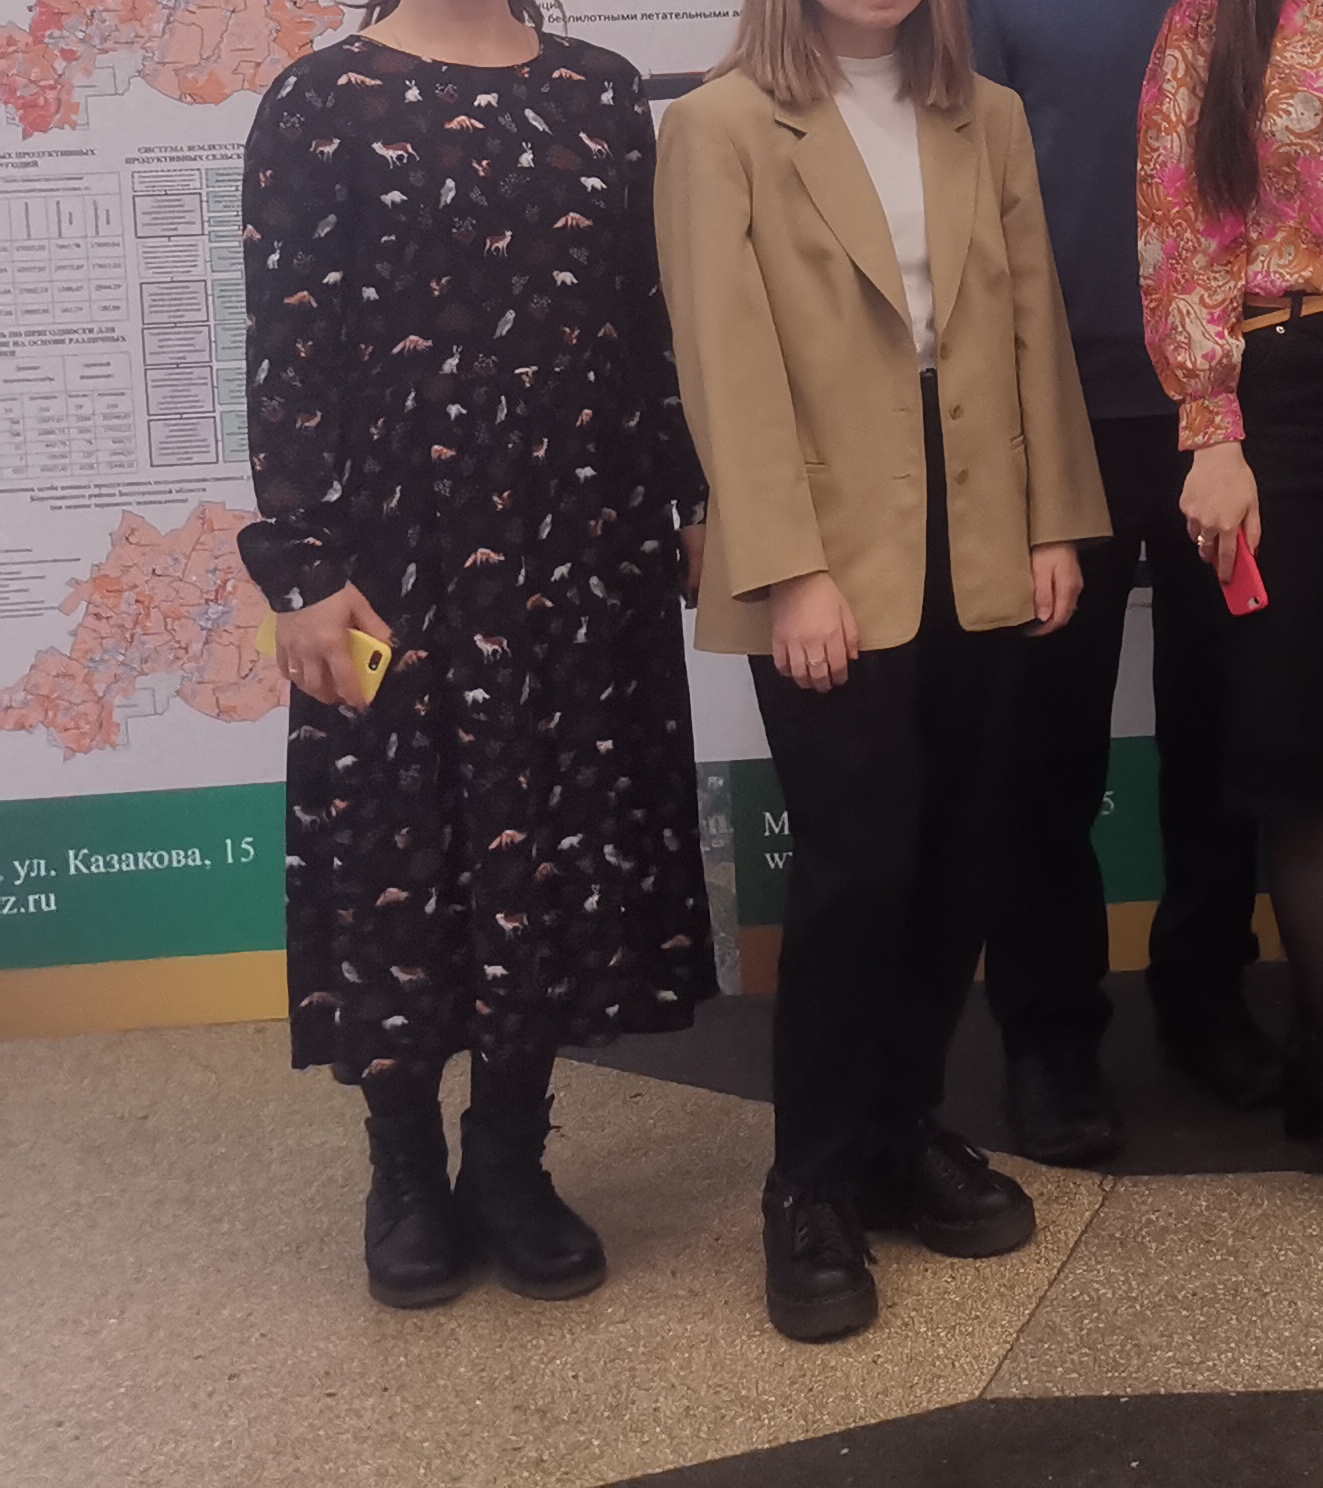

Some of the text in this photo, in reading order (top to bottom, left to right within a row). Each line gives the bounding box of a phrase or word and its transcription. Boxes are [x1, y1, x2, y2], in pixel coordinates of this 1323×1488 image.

[640, 10, 729, 21] летательными
[13, 837, 254, 885] ул. Казакова, 15
